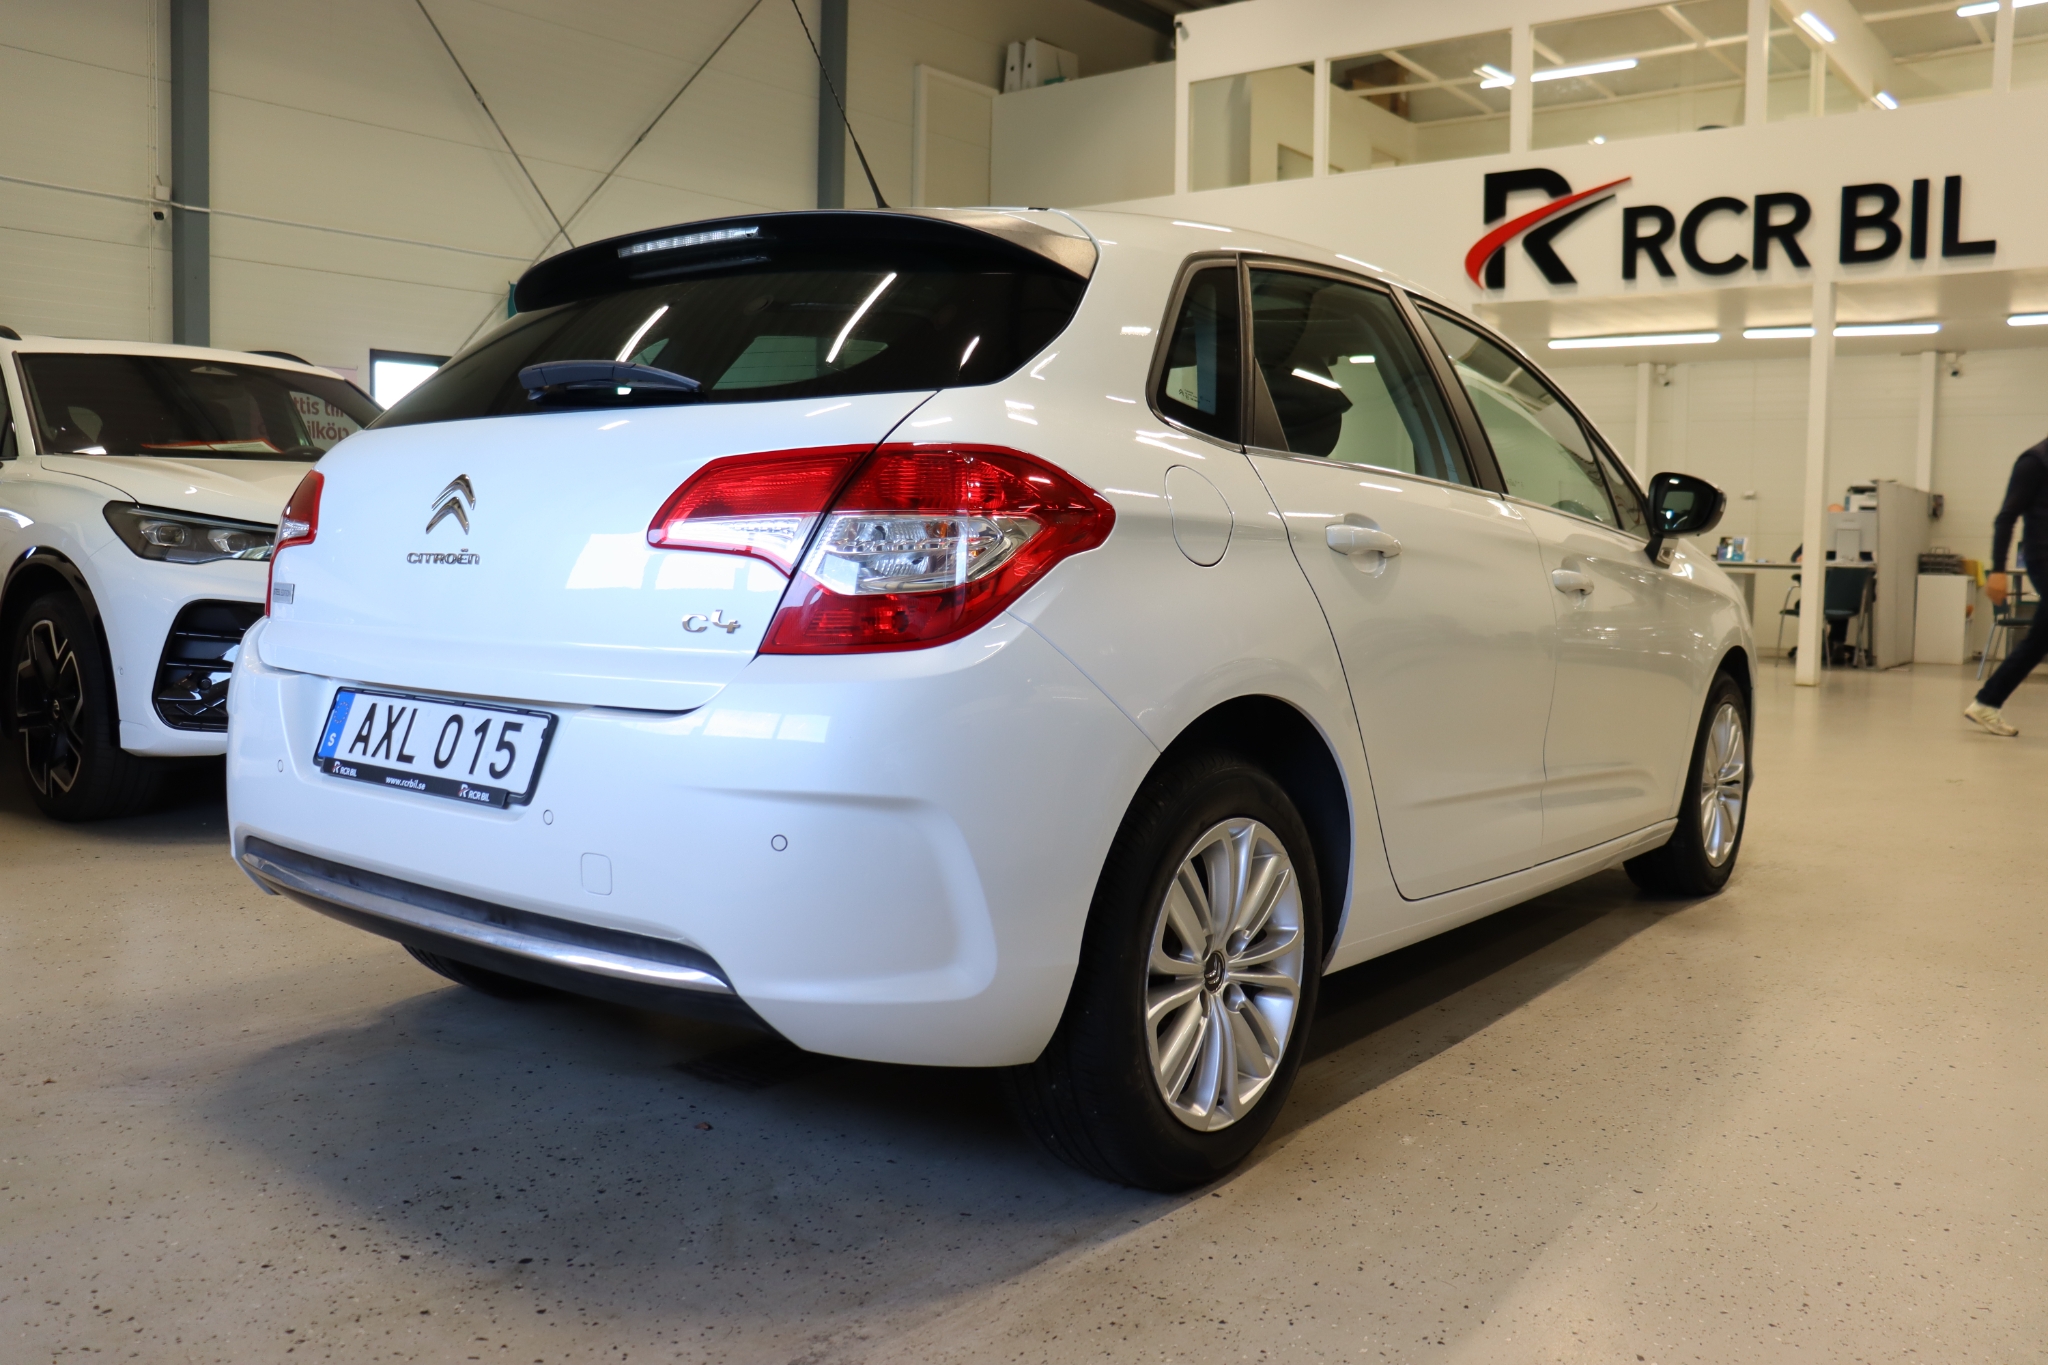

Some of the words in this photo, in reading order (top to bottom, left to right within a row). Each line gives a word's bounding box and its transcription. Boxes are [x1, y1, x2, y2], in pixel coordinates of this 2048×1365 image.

[1622, 192, 1812, 280] RCR
[1839, 175, 1997, 265] BIL
[682, 609, 742, 634] C4
[327, 732, 337, 747] S
[348, 703, 418, 764] AXL
[433, 714, 524, 780] 015
[385, 776, 426, 791] www.rcrbil.se
